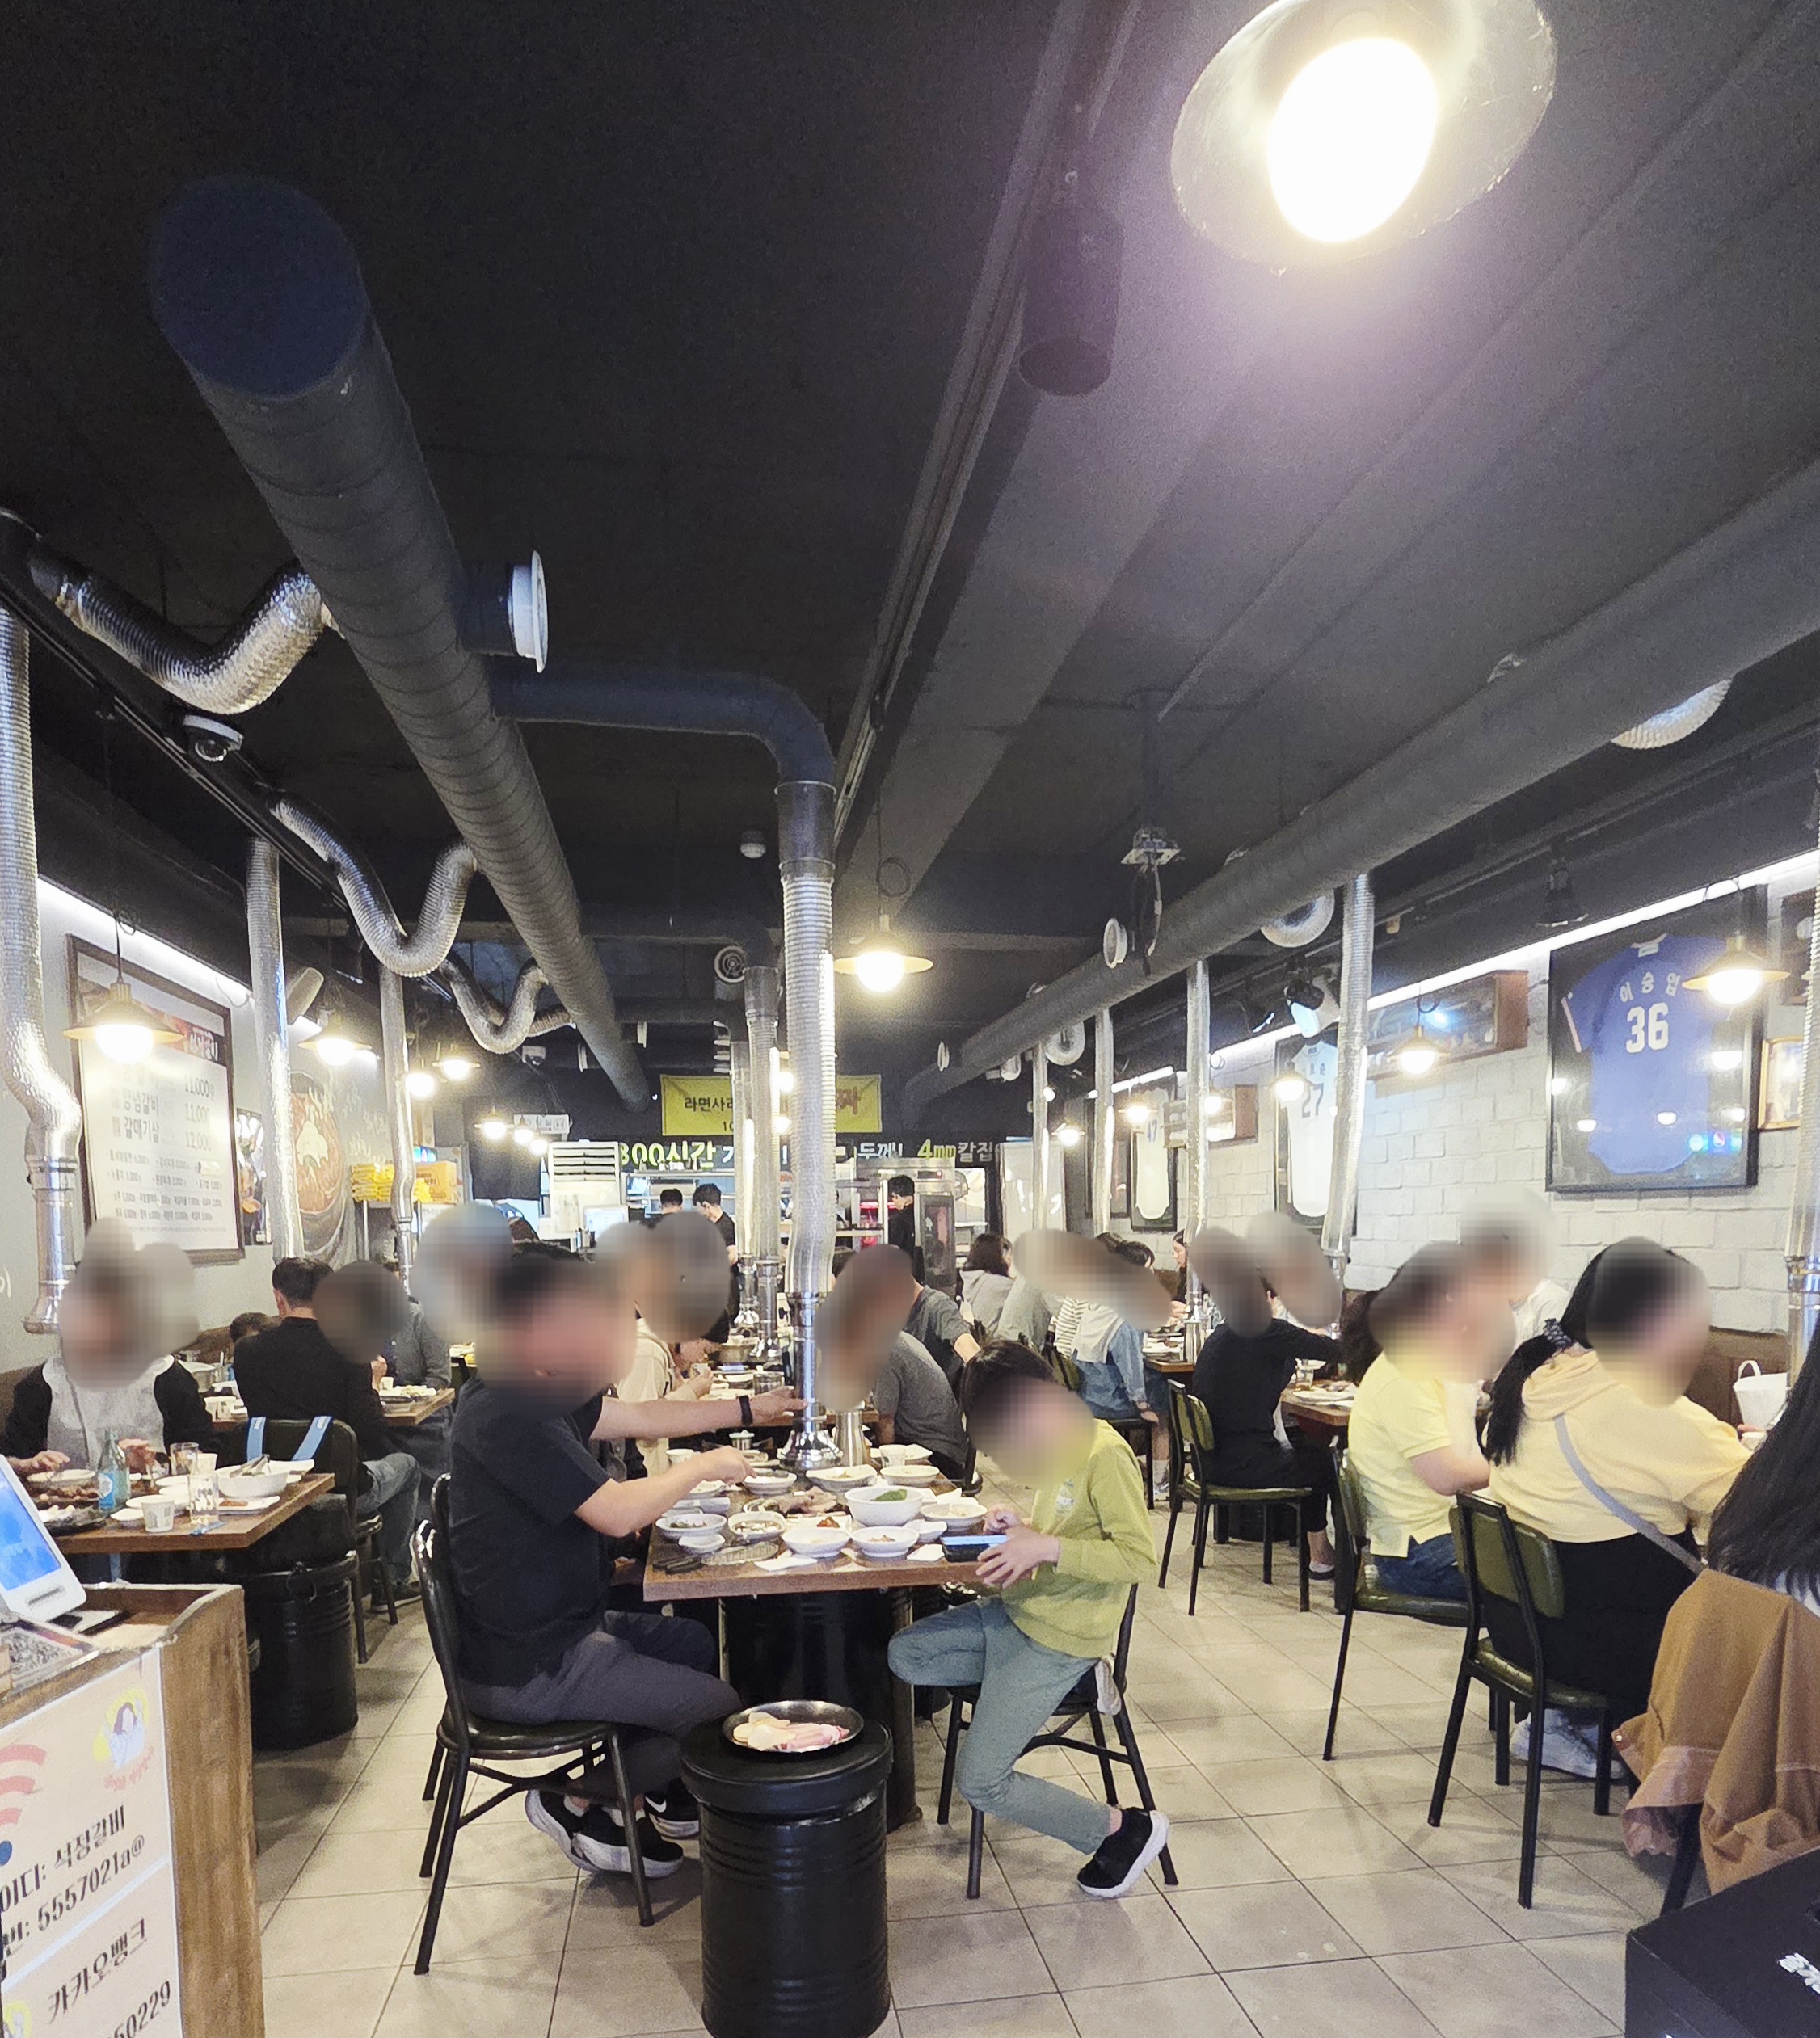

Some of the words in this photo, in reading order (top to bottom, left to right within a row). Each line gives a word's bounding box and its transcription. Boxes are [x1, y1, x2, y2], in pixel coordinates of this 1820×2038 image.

[1626, 1002, 1670, 1054] 36
[1301, 1083, 1325, 1118] 27
[54, 1804, 125, 1869] 석정갈비
[38, 1834, 145, 1931] 5557021a@
[48, 1918, 148, 2024] 카카오뱅크
